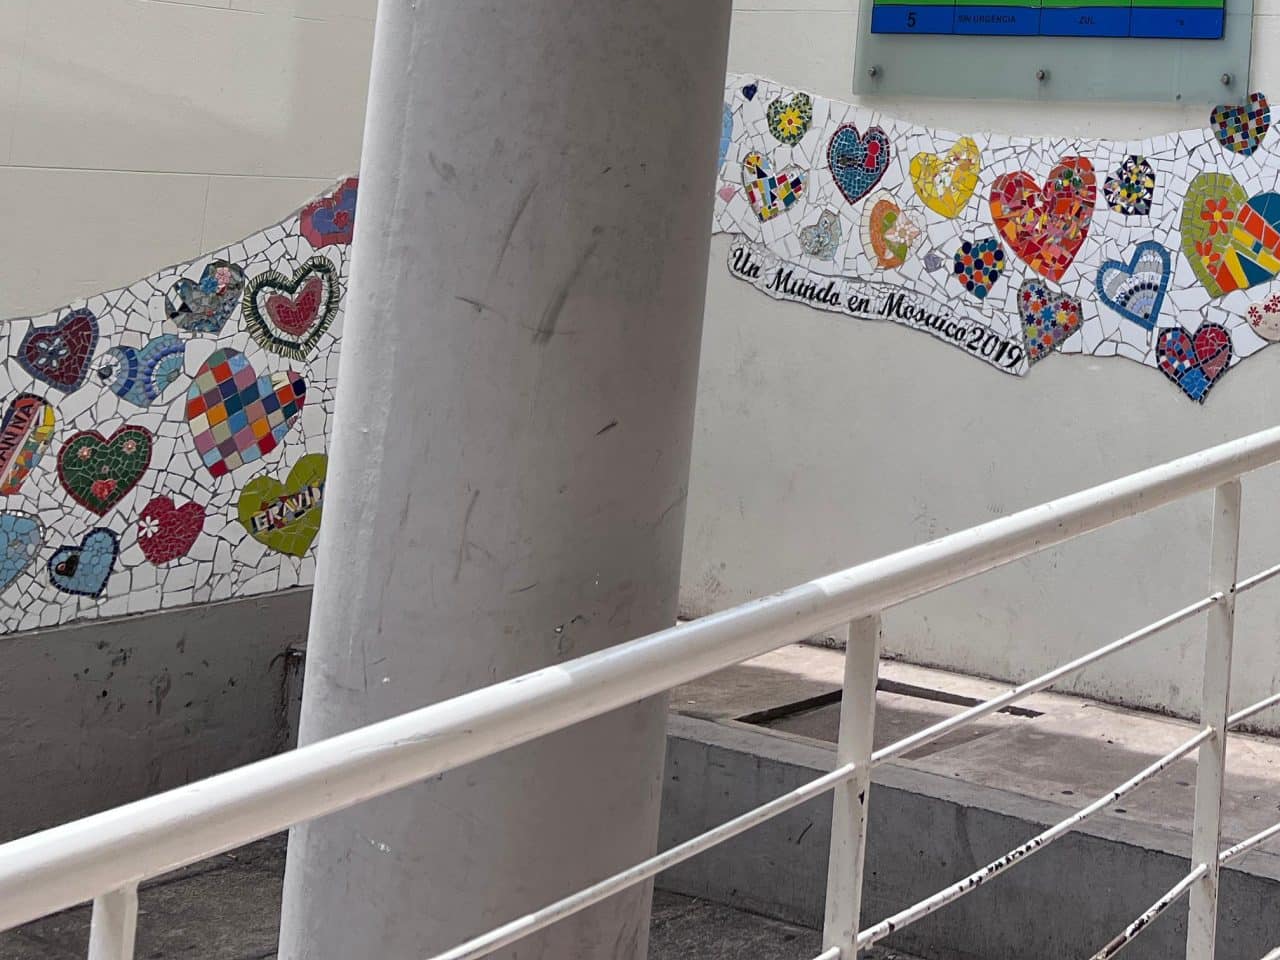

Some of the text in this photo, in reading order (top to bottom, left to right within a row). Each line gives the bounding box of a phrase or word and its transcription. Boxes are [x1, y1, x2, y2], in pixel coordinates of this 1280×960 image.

[906, 12, 917, 28] 5
[733, 247, 1022, 370] Un Mundo en Mosaico 2019
